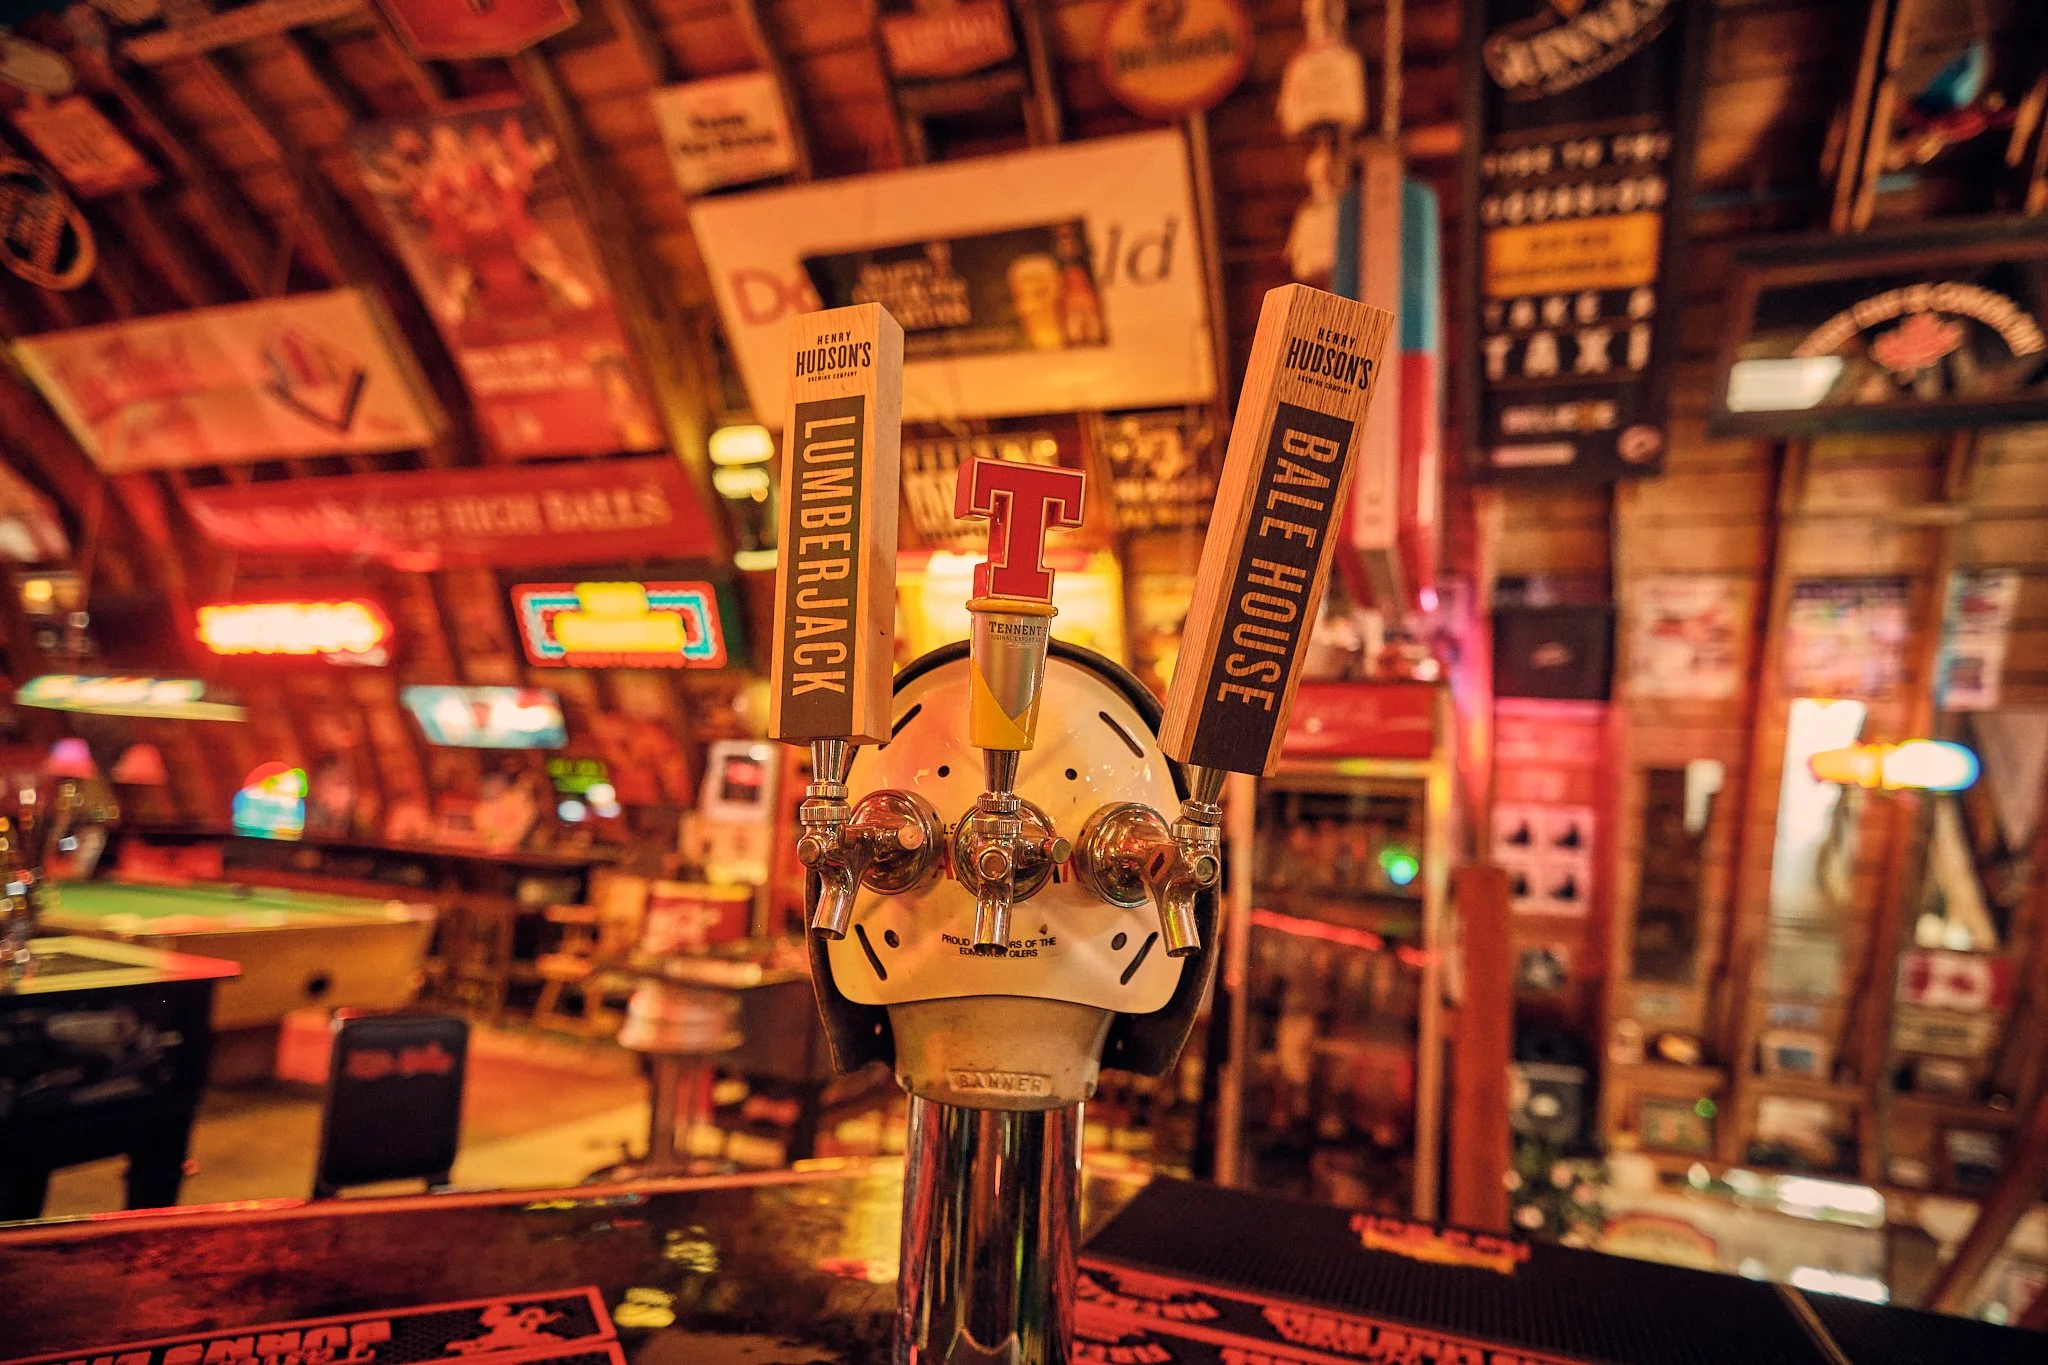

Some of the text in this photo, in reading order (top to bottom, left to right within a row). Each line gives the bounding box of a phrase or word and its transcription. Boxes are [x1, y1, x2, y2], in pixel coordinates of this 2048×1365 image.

[817, 330, 852, 345] HENRY
[1317, 327, 1356, 349] HENRY
[1484, 321, 1651, 382] TAXI
[796, 341, 871, 377] HUDSON'S
[1285, 337, 1373, 390] HUDSON'S
[833, 371, 858, 380] COMPANY
[954, 456, 1086, 601] T
[792, 415, 856, 697] LUMBERJACK
[1217, 427, 1340, 711] BALE HOUSE
[941, 933, 971, 947] PROUD
[1025, 940, 1037, 948] OF
[1040, 937, 1057, 946] THE
[1009, 949, 1038, 958] OILERS
[958, 1073, 1042, 1092] BANNER
